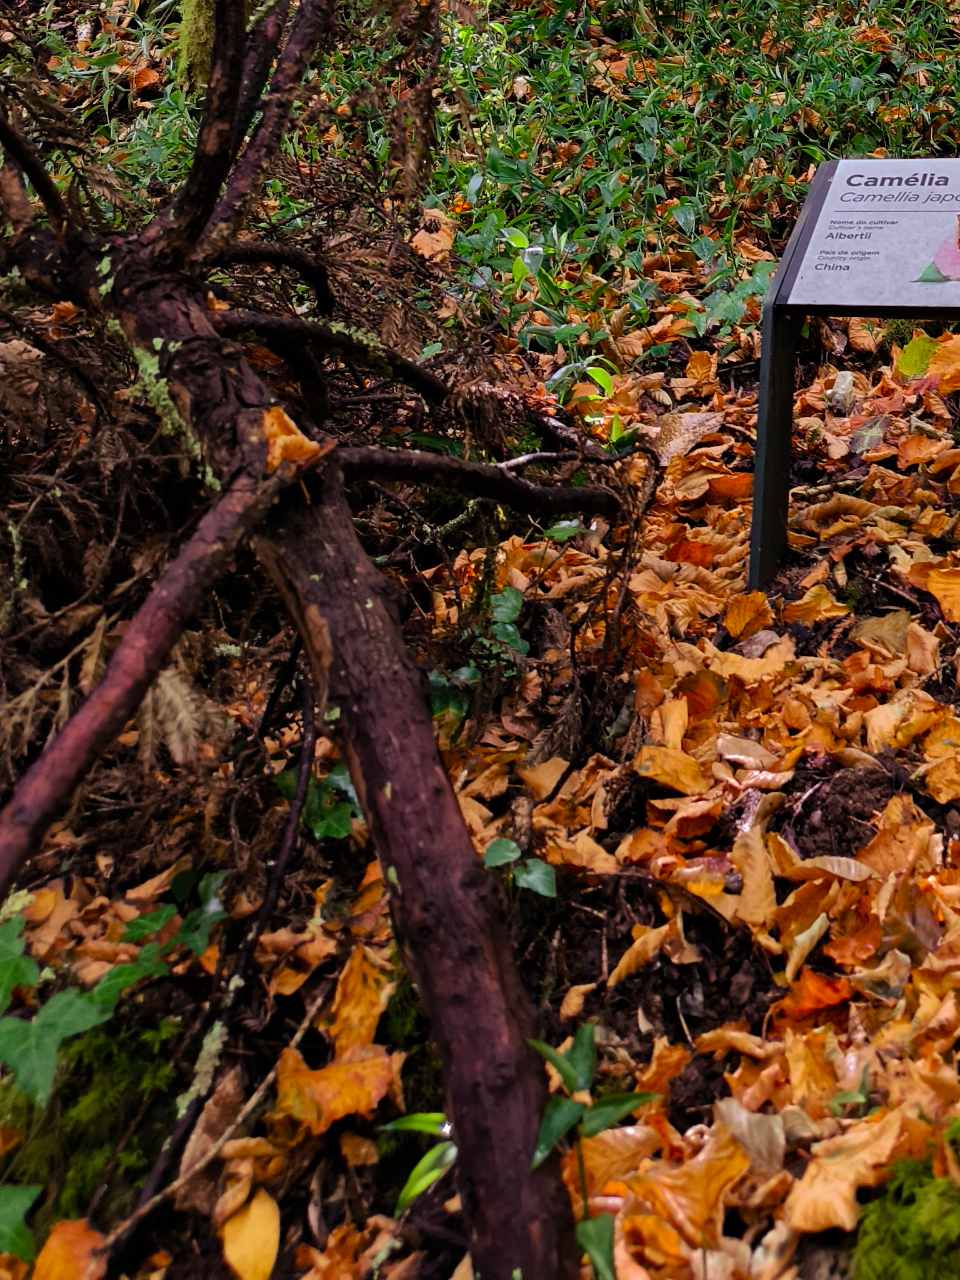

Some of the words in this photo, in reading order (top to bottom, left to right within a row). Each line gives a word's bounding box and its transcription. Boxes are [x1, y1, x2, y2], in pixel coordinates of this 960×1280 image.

[846, 173, 950, 187] Camélia
[840, 191, 920, 203] Camellia
[814, 263, 851, 271] China
